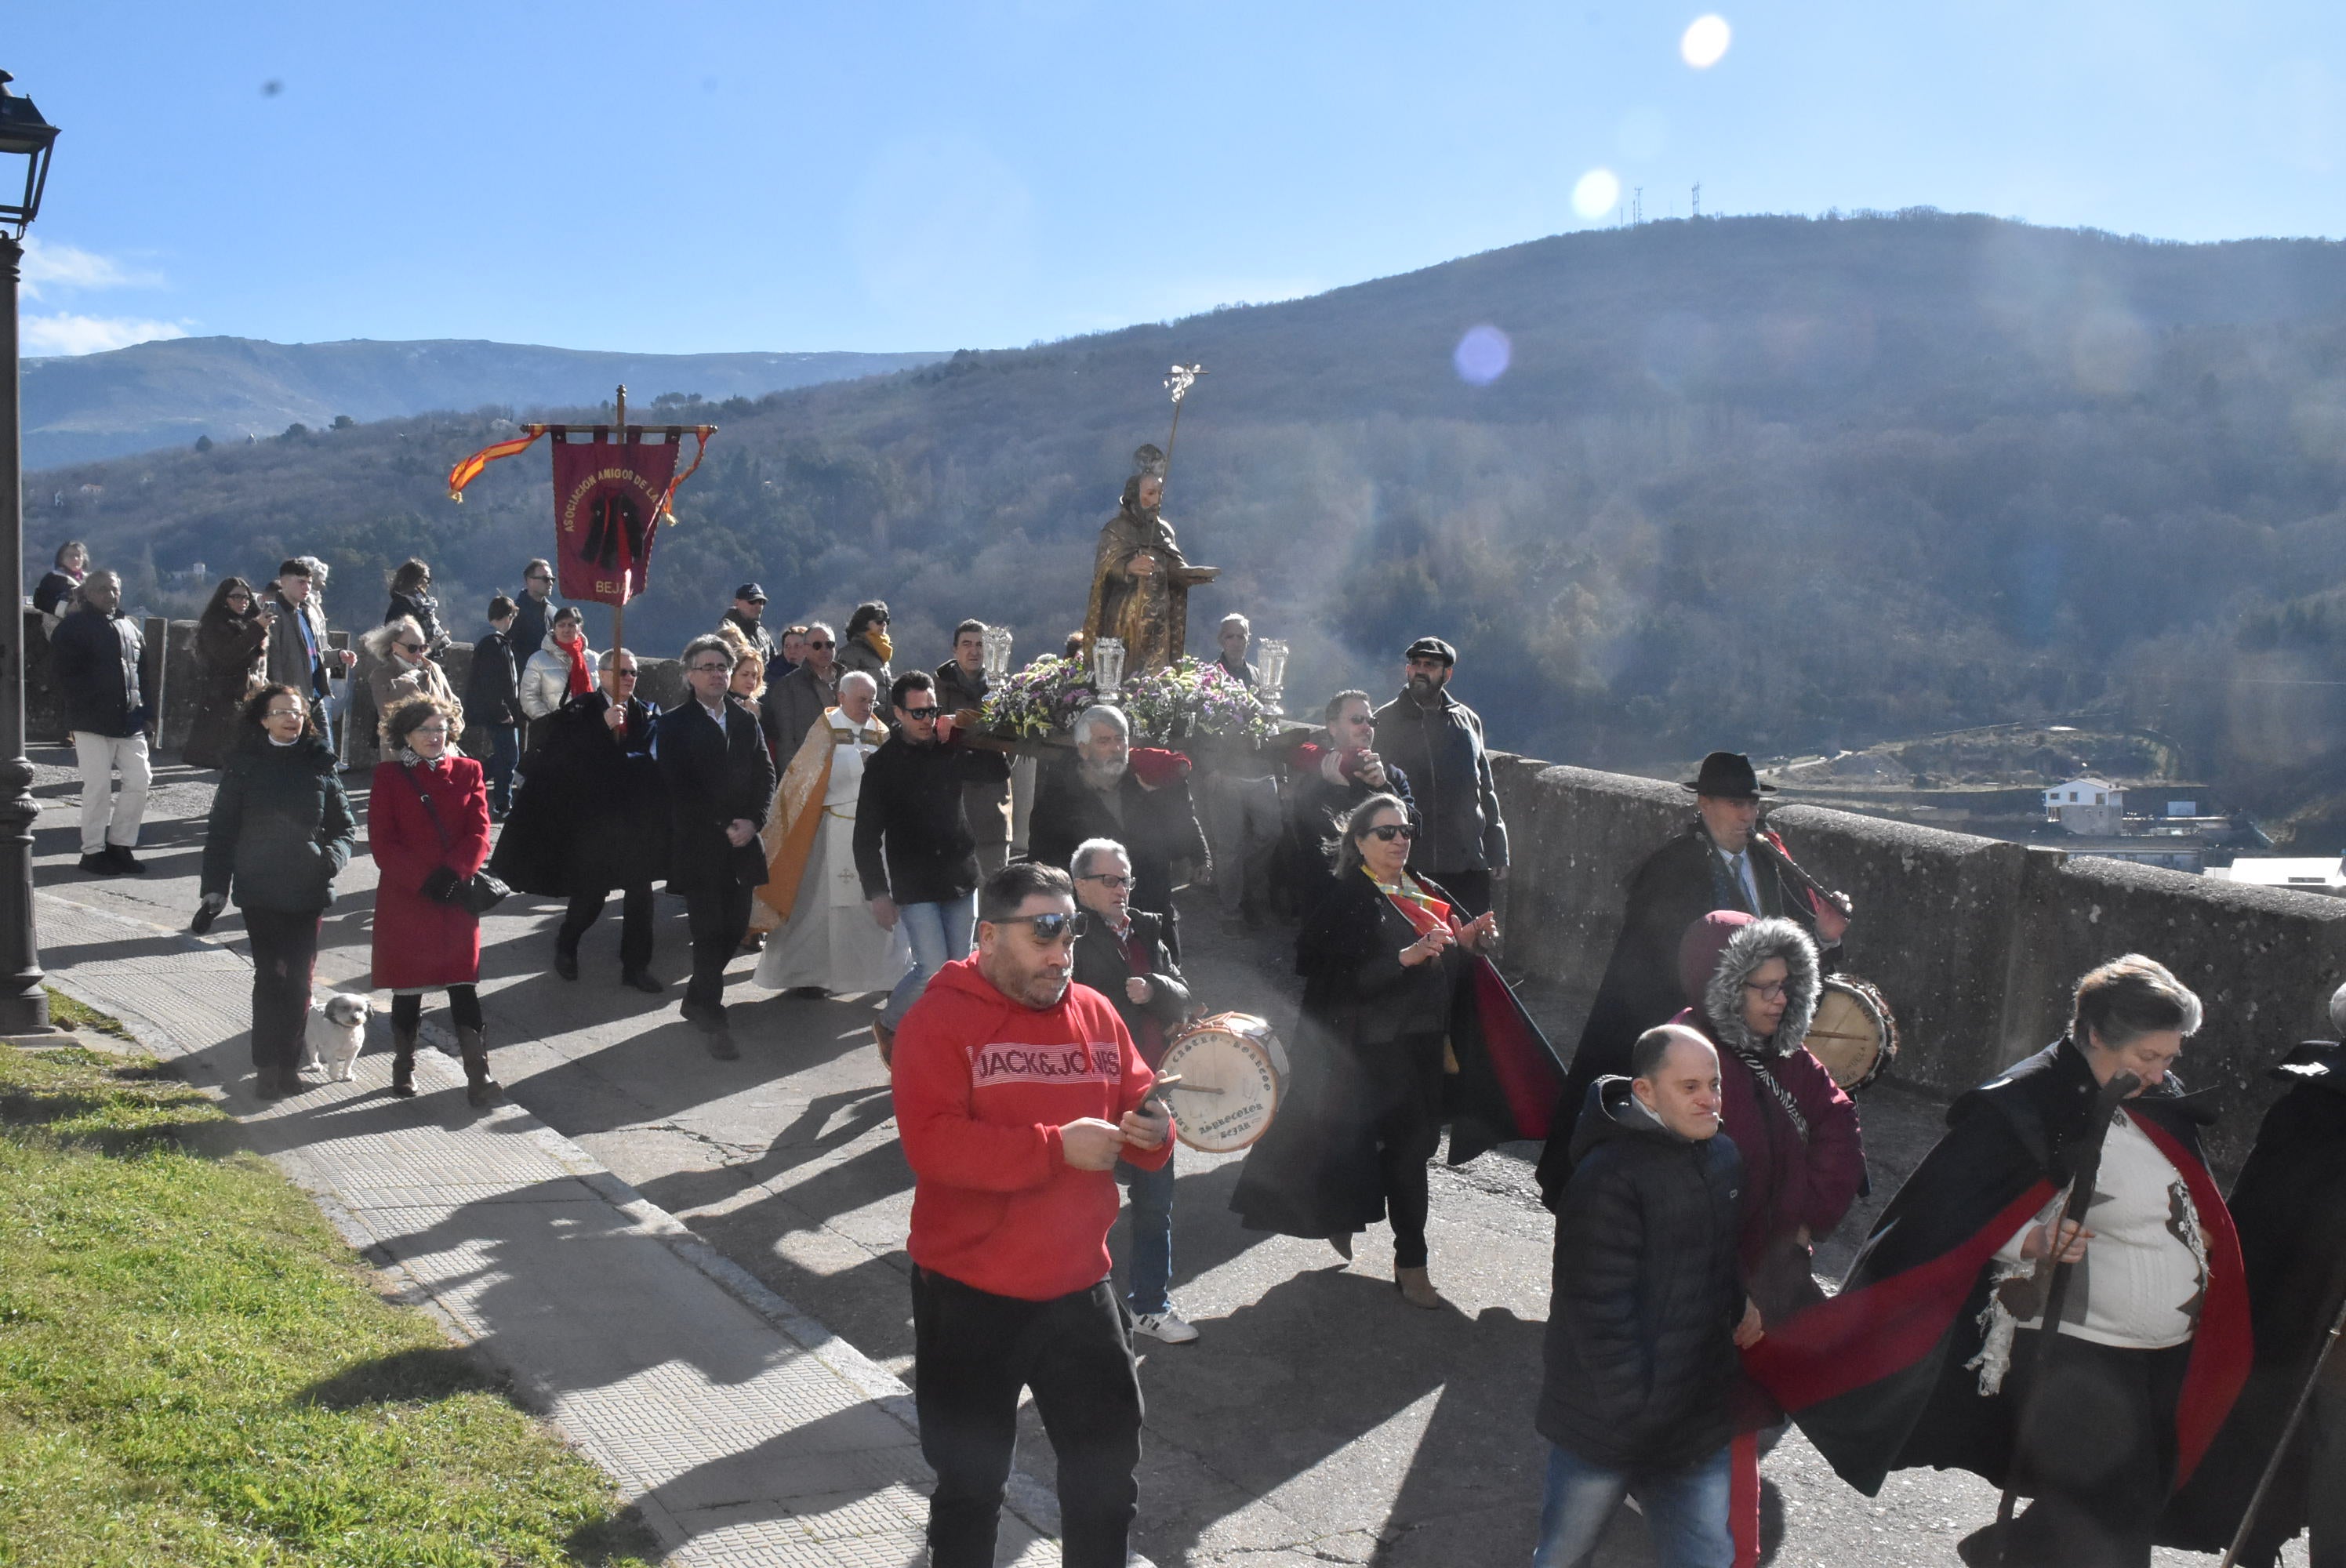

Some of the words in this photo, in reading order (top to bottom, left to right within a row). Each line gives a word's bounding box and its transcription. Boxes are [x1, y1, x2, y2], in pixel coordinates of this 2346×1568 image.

[564, 474, 597, 532] ASOCIACION
[597, 467, 634, 481] AMIGOS
[634, 474, 648, 488] DE
[645, 486, 660, 504] LA
[595, 580, 632, 594] BEJA
[1220, 1122, 1252, 1138] BEJAR
